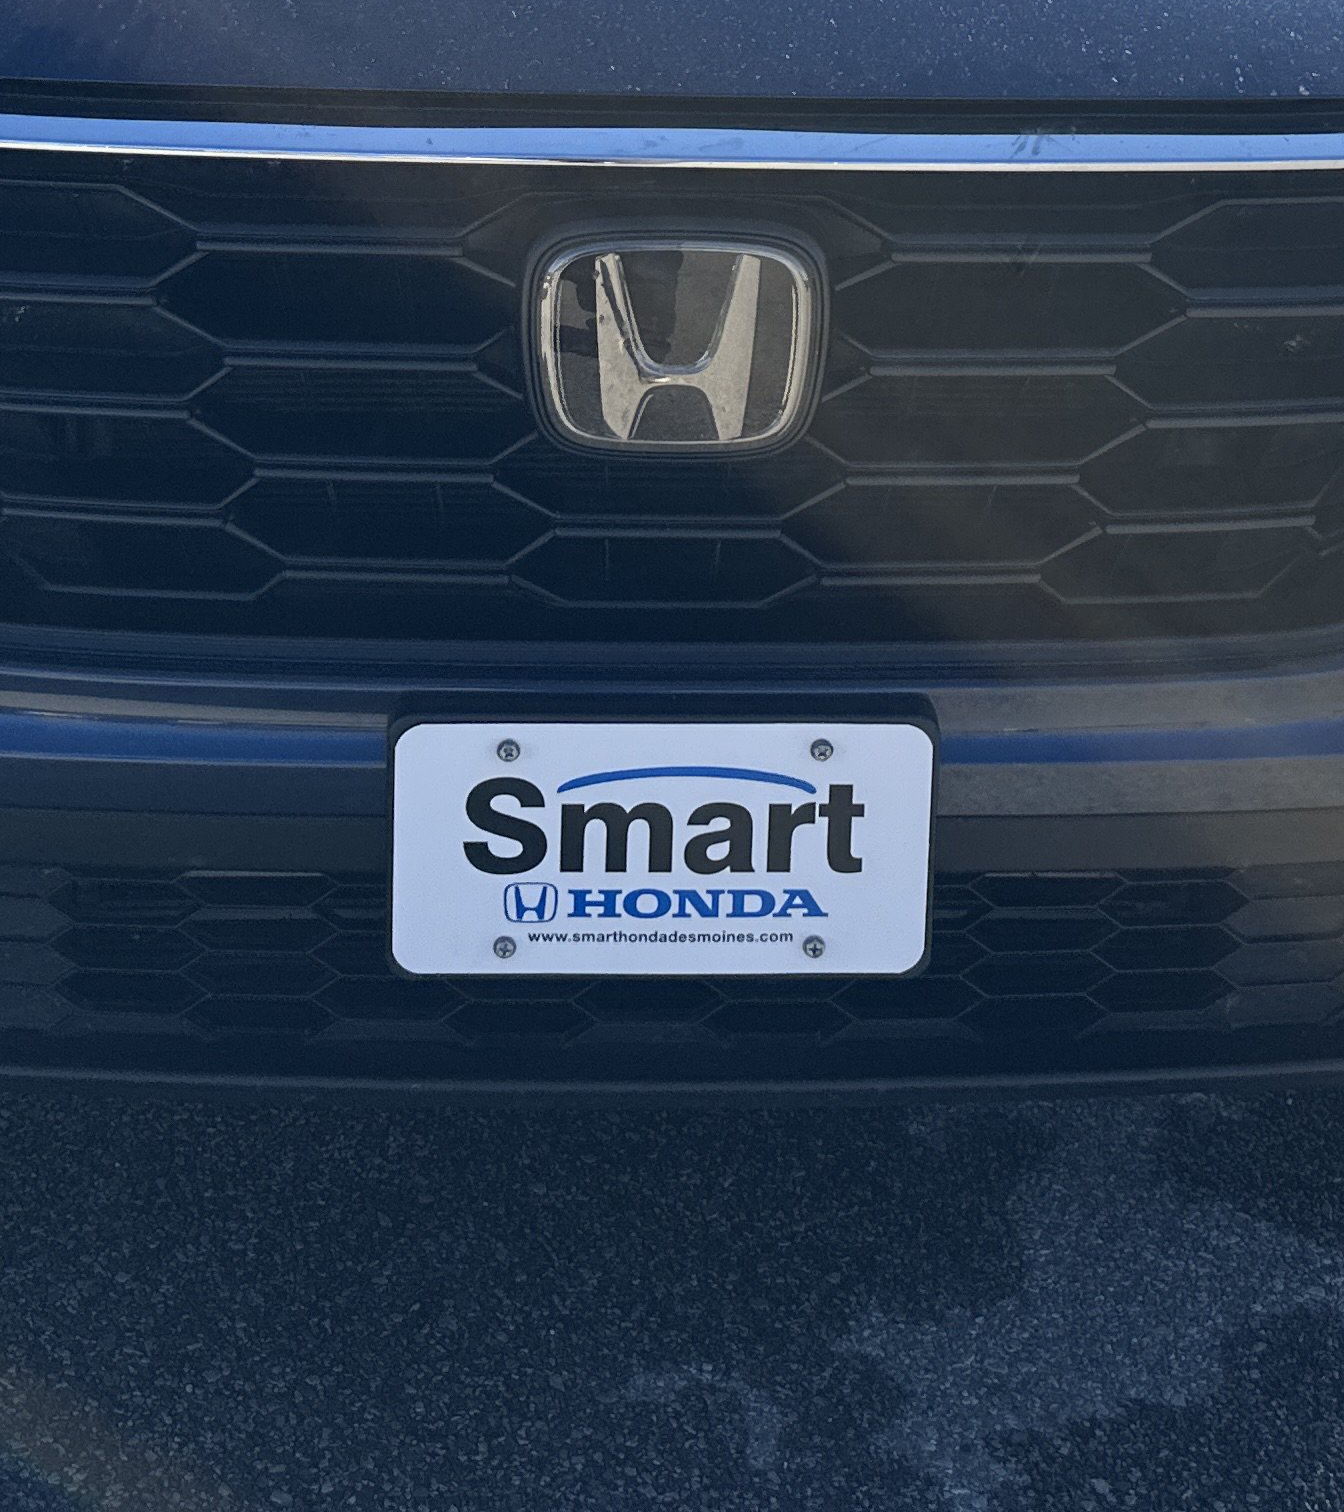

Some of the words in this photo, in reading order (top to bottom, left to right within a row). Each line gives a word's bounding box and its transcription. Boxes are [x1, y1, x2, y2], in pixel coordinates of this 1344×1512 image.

[462, 776, 865, 875] Smart
[567, 888, 829, 919] HONDA
[527, 930, 794, 944] www.smarthondadesmoines.com
